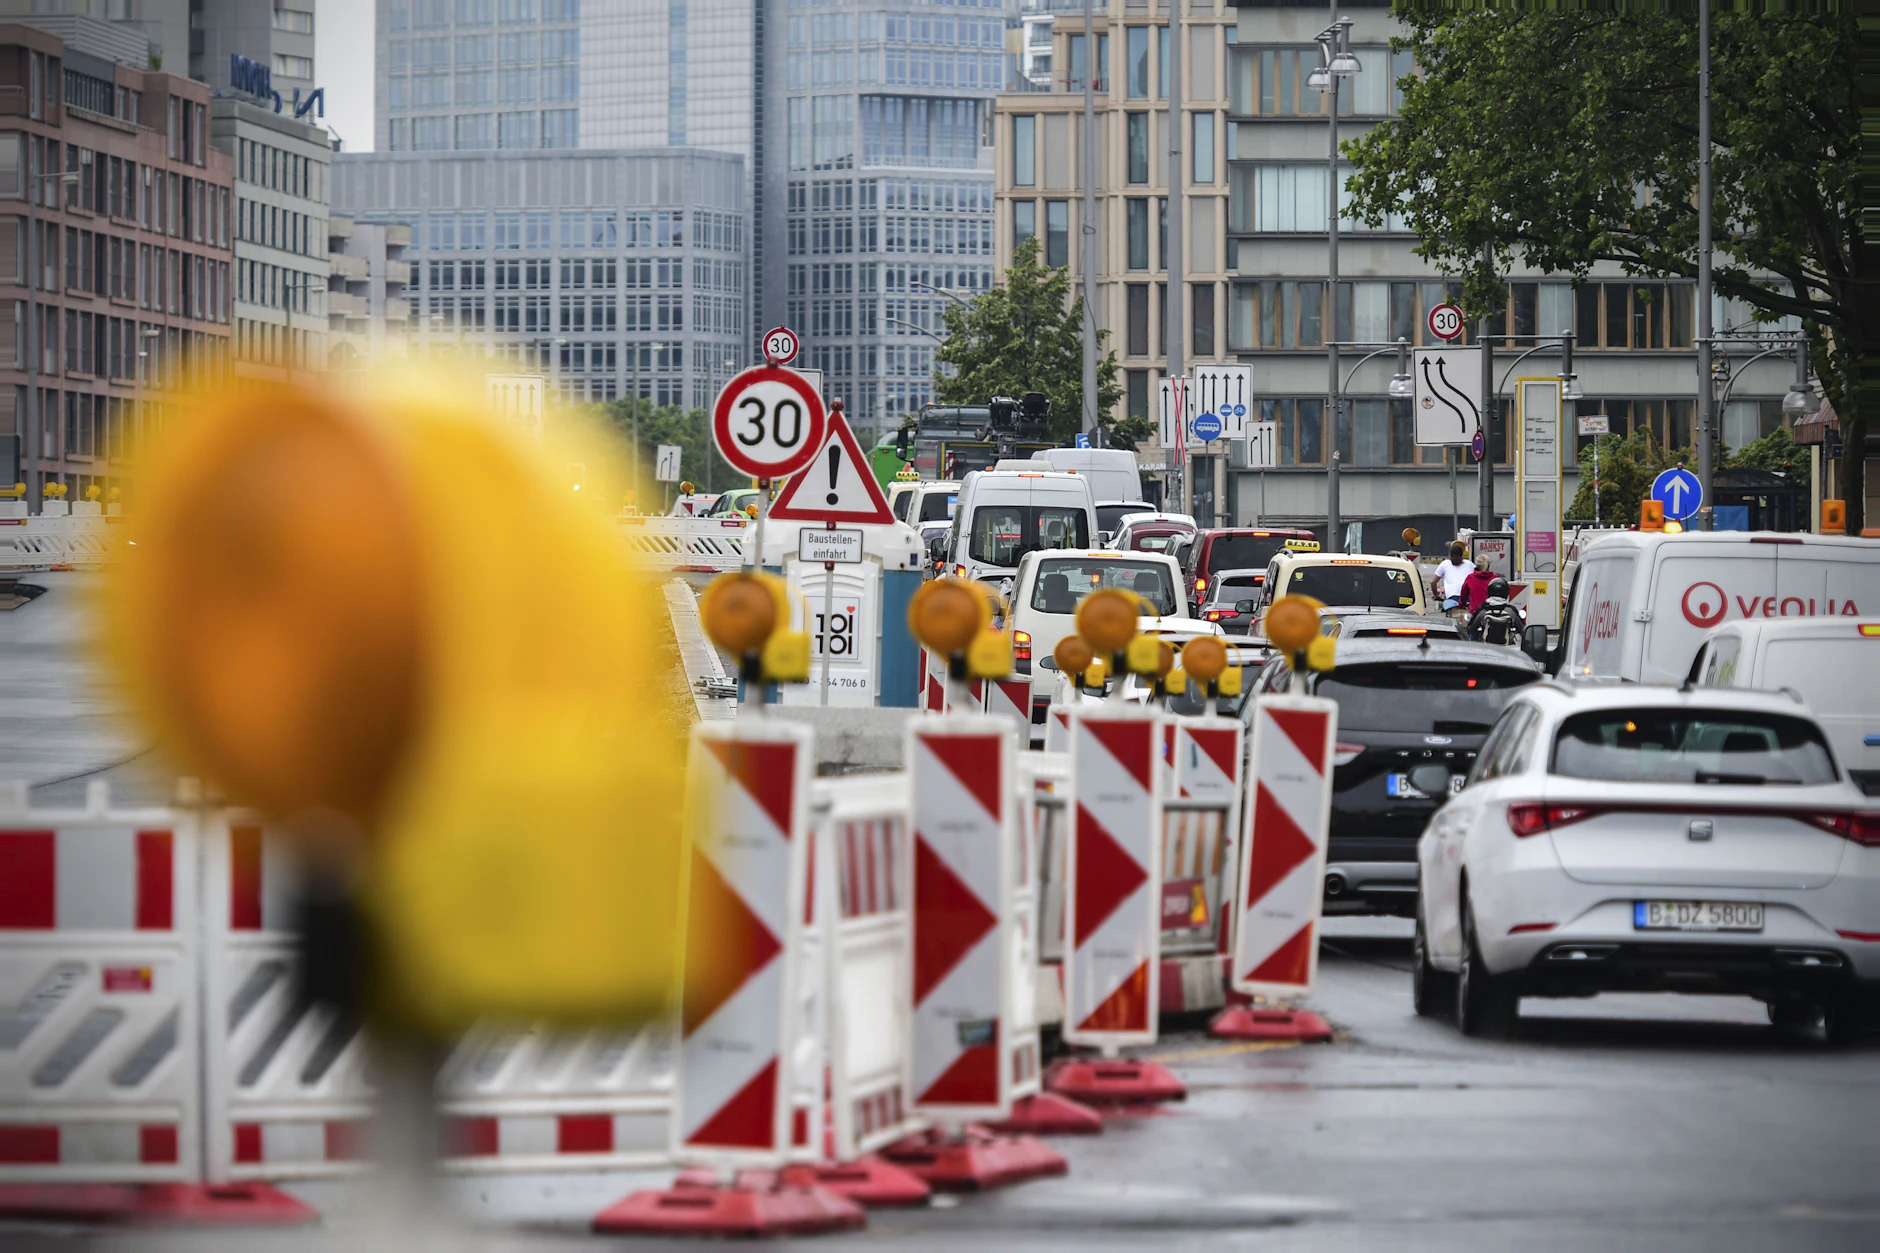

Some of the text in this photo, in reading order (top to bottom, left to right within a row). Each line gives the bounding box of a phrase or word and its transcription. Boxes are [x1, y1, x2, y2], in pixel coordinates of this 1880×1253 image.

[1436, 313, 1457, 330] 30
[770, 337, 791, 354] 30
[737, 396, 802, 448] 30
[808, 533, 858, 545] Baustellen-
[1288, 540, 1316, 548] TAXI
[813, 548, 847, 560] einfahrt
[1594, 600, 1621, 640] VEOLIA
[820, 677, 837, 687] 64
[840, 678, 857, 688] 706
[860, 679, 866, 688] 0
[1649, 903, 1760, 925] B DZ 5800
